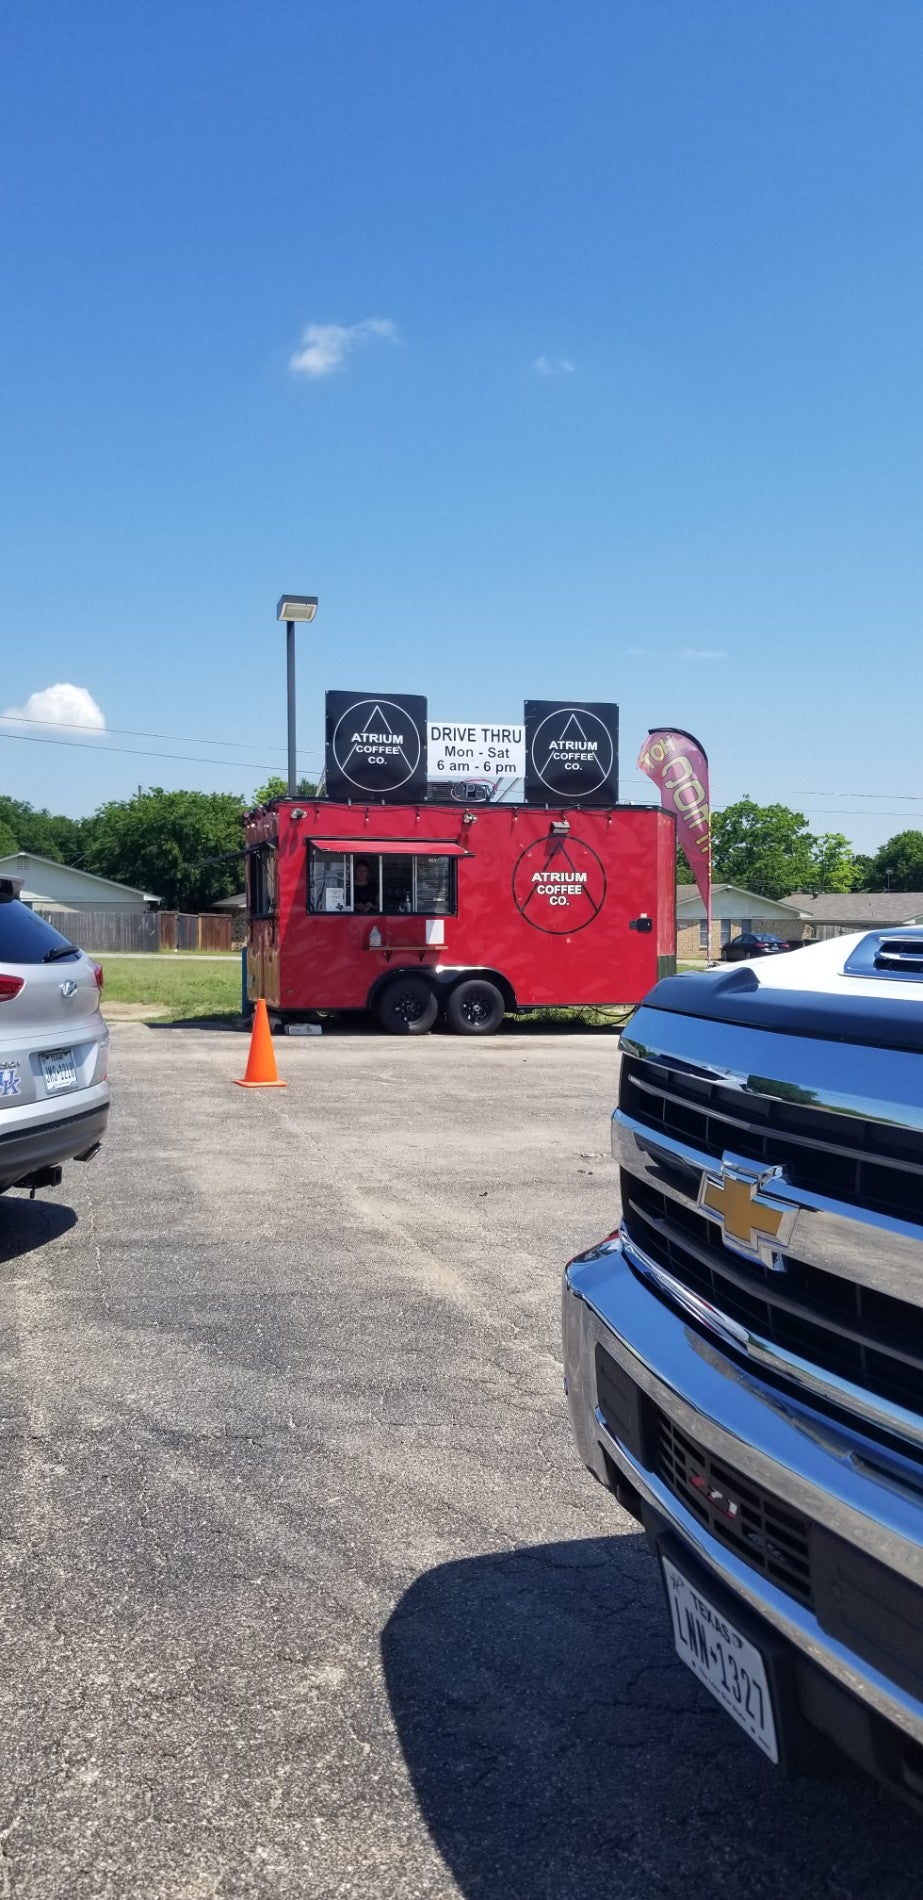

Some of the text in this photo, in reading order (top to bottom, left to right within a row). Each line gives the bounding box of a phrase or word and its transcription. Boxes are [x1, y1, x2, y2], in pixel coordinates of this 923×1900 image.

[351, 732, 404, 745] ATRIUM
[430, 726, 522, 744] DRIVE THRU
[355, 744, 400, 755] COFFEE
[548, 740, 598, 751] ATRIUM
[444, 745, 474, 758] Mon
[487, 746, 510, 759] Sat
[552, 752, 594, 761] COFFEE
[367, 755, 388, 765] CO.
[436, 758, 445, 771] 6
[449, 762, 470, 772] am
[483, 760, 491, 773] 6
[495, 764, 517, 775] pm
[564, 762, 583, 771] CO.
[531, 872, 588, 882] ATRIUM
[537, 884, 582, 895] COFFEE
[549, 896, 570, 906] CO.
[690, 1591, 731, 1644] TEXAS
